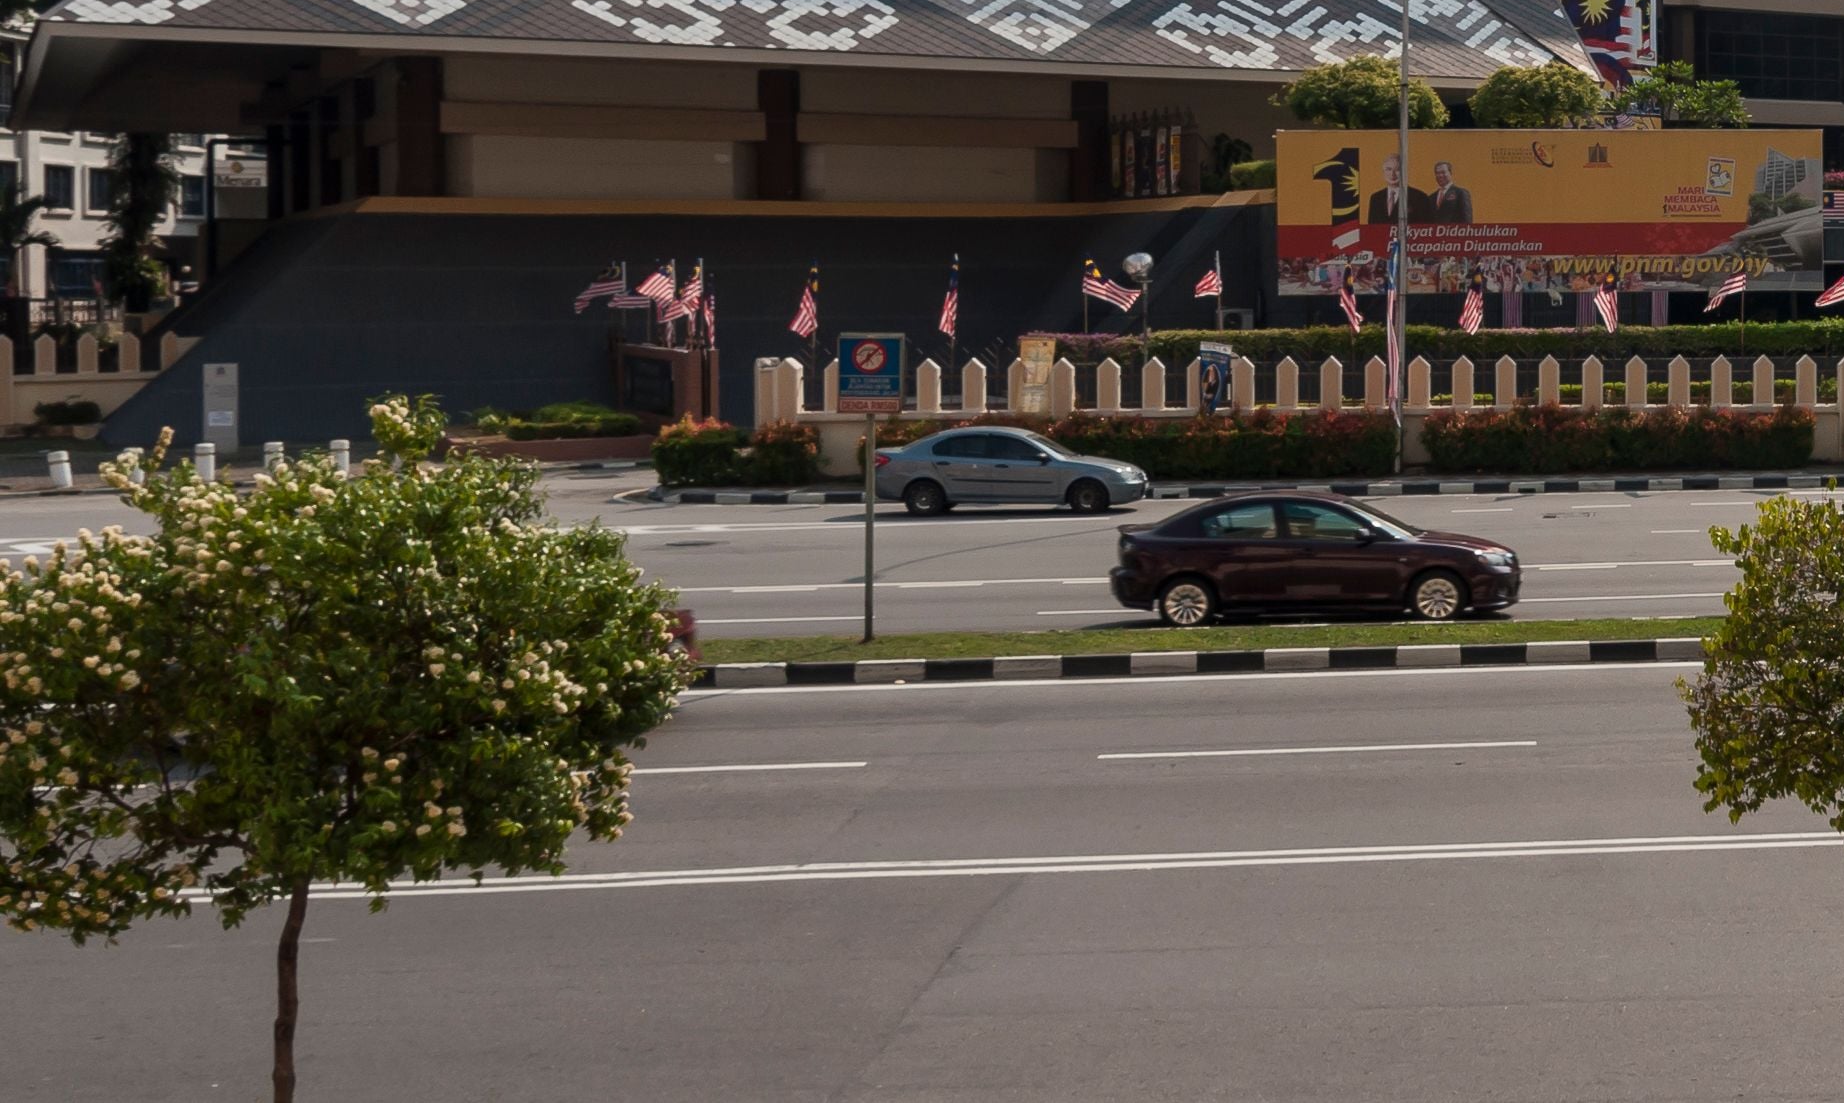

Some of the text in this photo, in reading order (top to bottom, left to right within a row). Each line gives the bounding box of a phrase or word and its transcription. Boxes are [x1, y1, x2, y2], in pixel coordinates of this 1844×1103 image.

[1678, 186, 1705, 194] MARI
[1664, 195, 1717, 203] MEMBACA
[1389, 225, 1518, 240] Rkyat Didahulukan
[1464, 240, 1543, 252] Diutamakan
